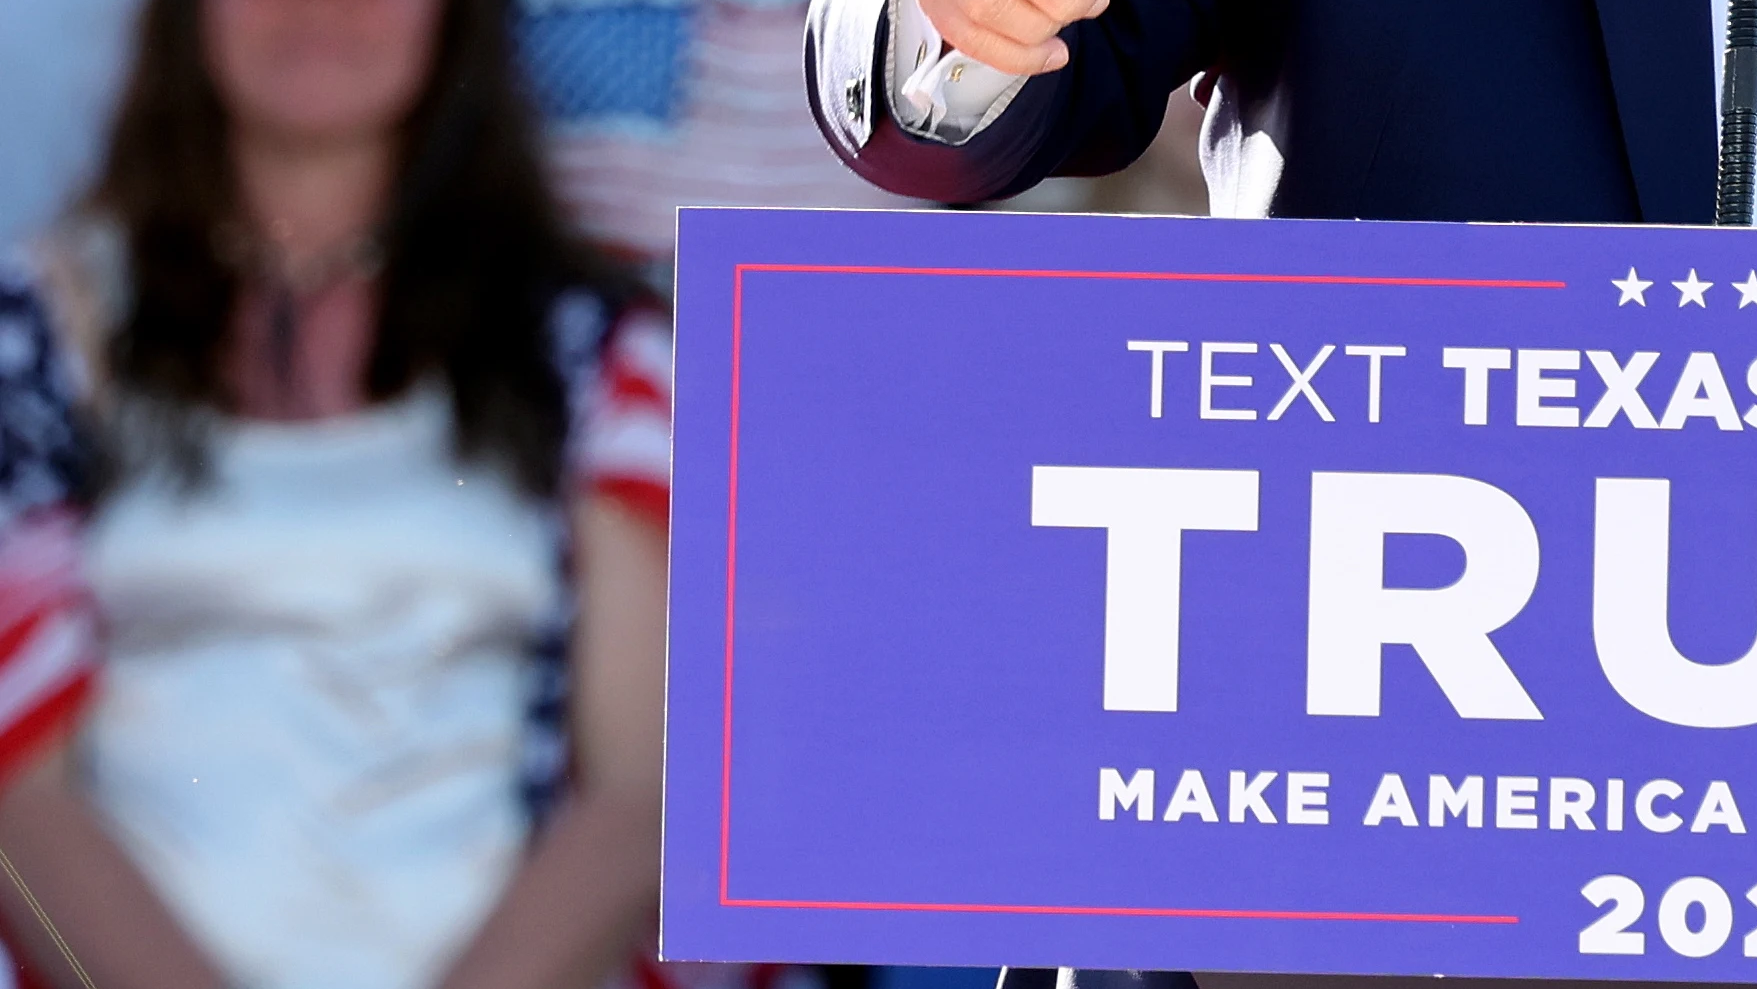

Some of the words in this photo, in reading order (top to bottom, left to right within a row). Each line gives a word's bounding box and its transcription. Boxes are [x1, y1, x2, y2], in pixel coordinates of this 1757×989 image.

[1126, 340, 1407, 423] TEXT
[1098, 767, 1330, 825] MAKE
[1362, 772, 1747, 834] AMERICA
